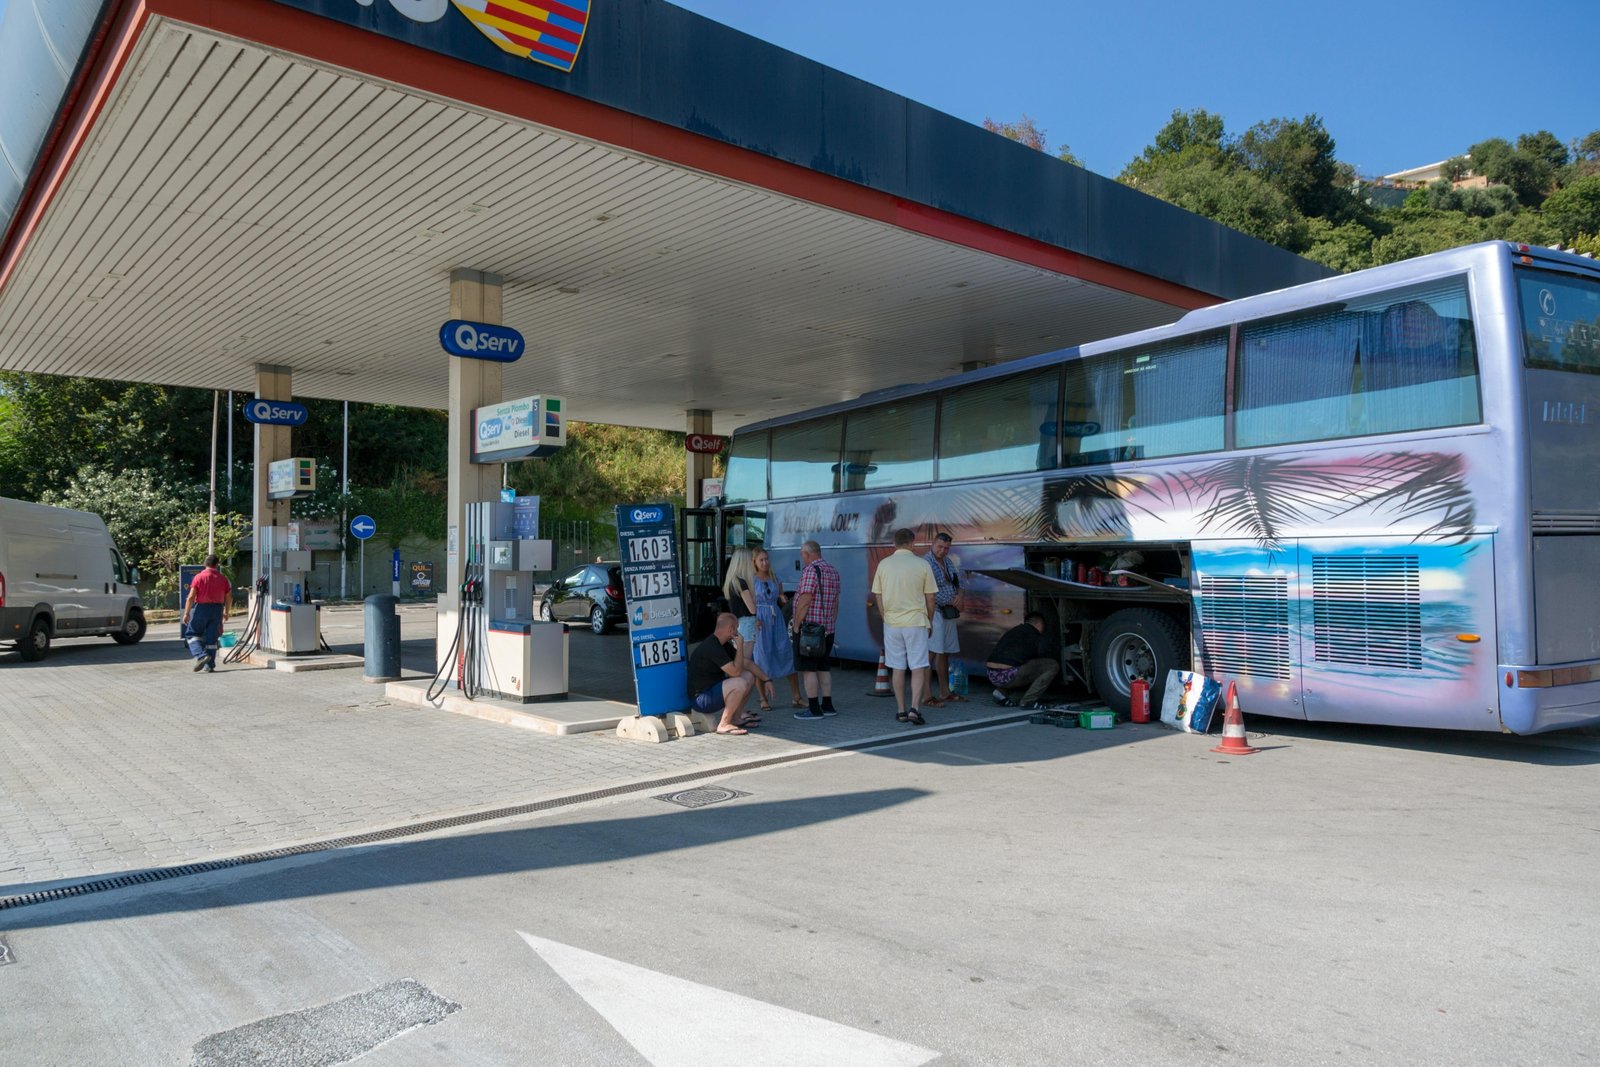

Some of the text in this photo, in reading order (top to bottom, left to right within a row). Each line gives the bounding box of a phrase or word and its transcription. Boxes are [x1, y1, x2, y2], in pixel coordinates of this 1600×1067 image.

[455, 324, 518, 353] QServ
[254, 402, 302, 420] QServ
[496, 401, 530, 417] Senza Piombo
[534, 401, 539, 411] 5
[480, 421, 501, 439] QServ
[514, 428, 530, 438] Diesel
[691, 436, 721, 451] QSelf
[634, 509, 657, 521] QServ
[630, 538, 668, 561] 1,603
[632, 572, 670, 597] 1,753
[641, 640, 678, 665] 1,863
